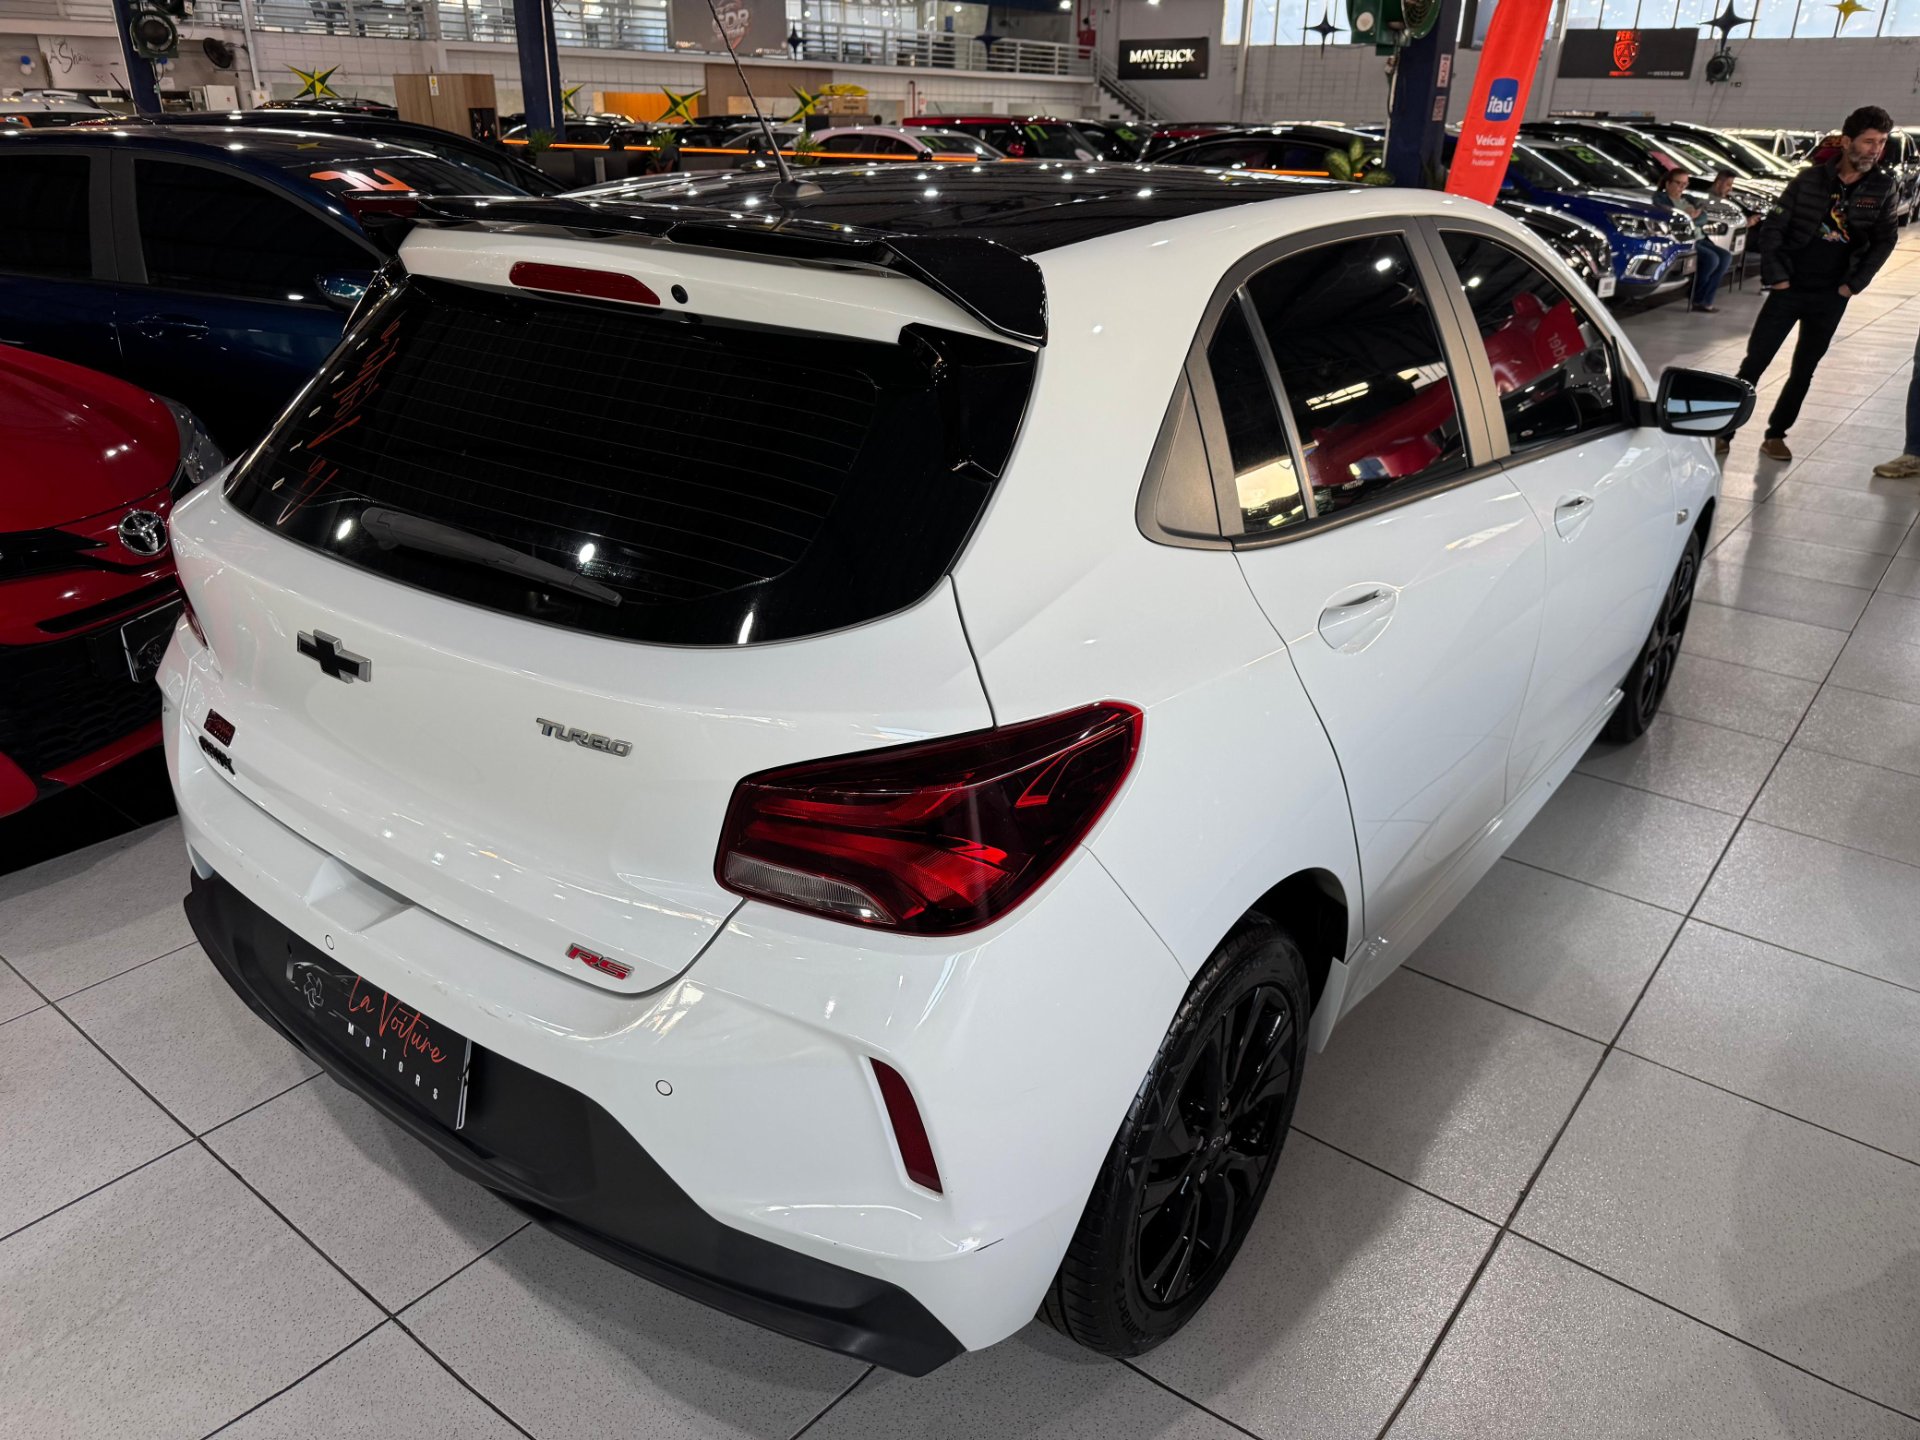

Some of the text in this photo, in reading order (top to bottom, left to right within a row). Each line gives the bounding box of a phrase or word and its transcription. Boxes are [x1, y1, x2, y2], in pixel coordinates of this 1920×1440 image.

[1129, 49, 1195, 63] MAVERICK
[1487, 96, 1514, 113] itaú
[536, 717, 633, 757] TURBO
[565, 942, 635, 980] RS
[378, 991, 447, 1064] Voiture
[347, 1022, 439, 1100] MOTORS
